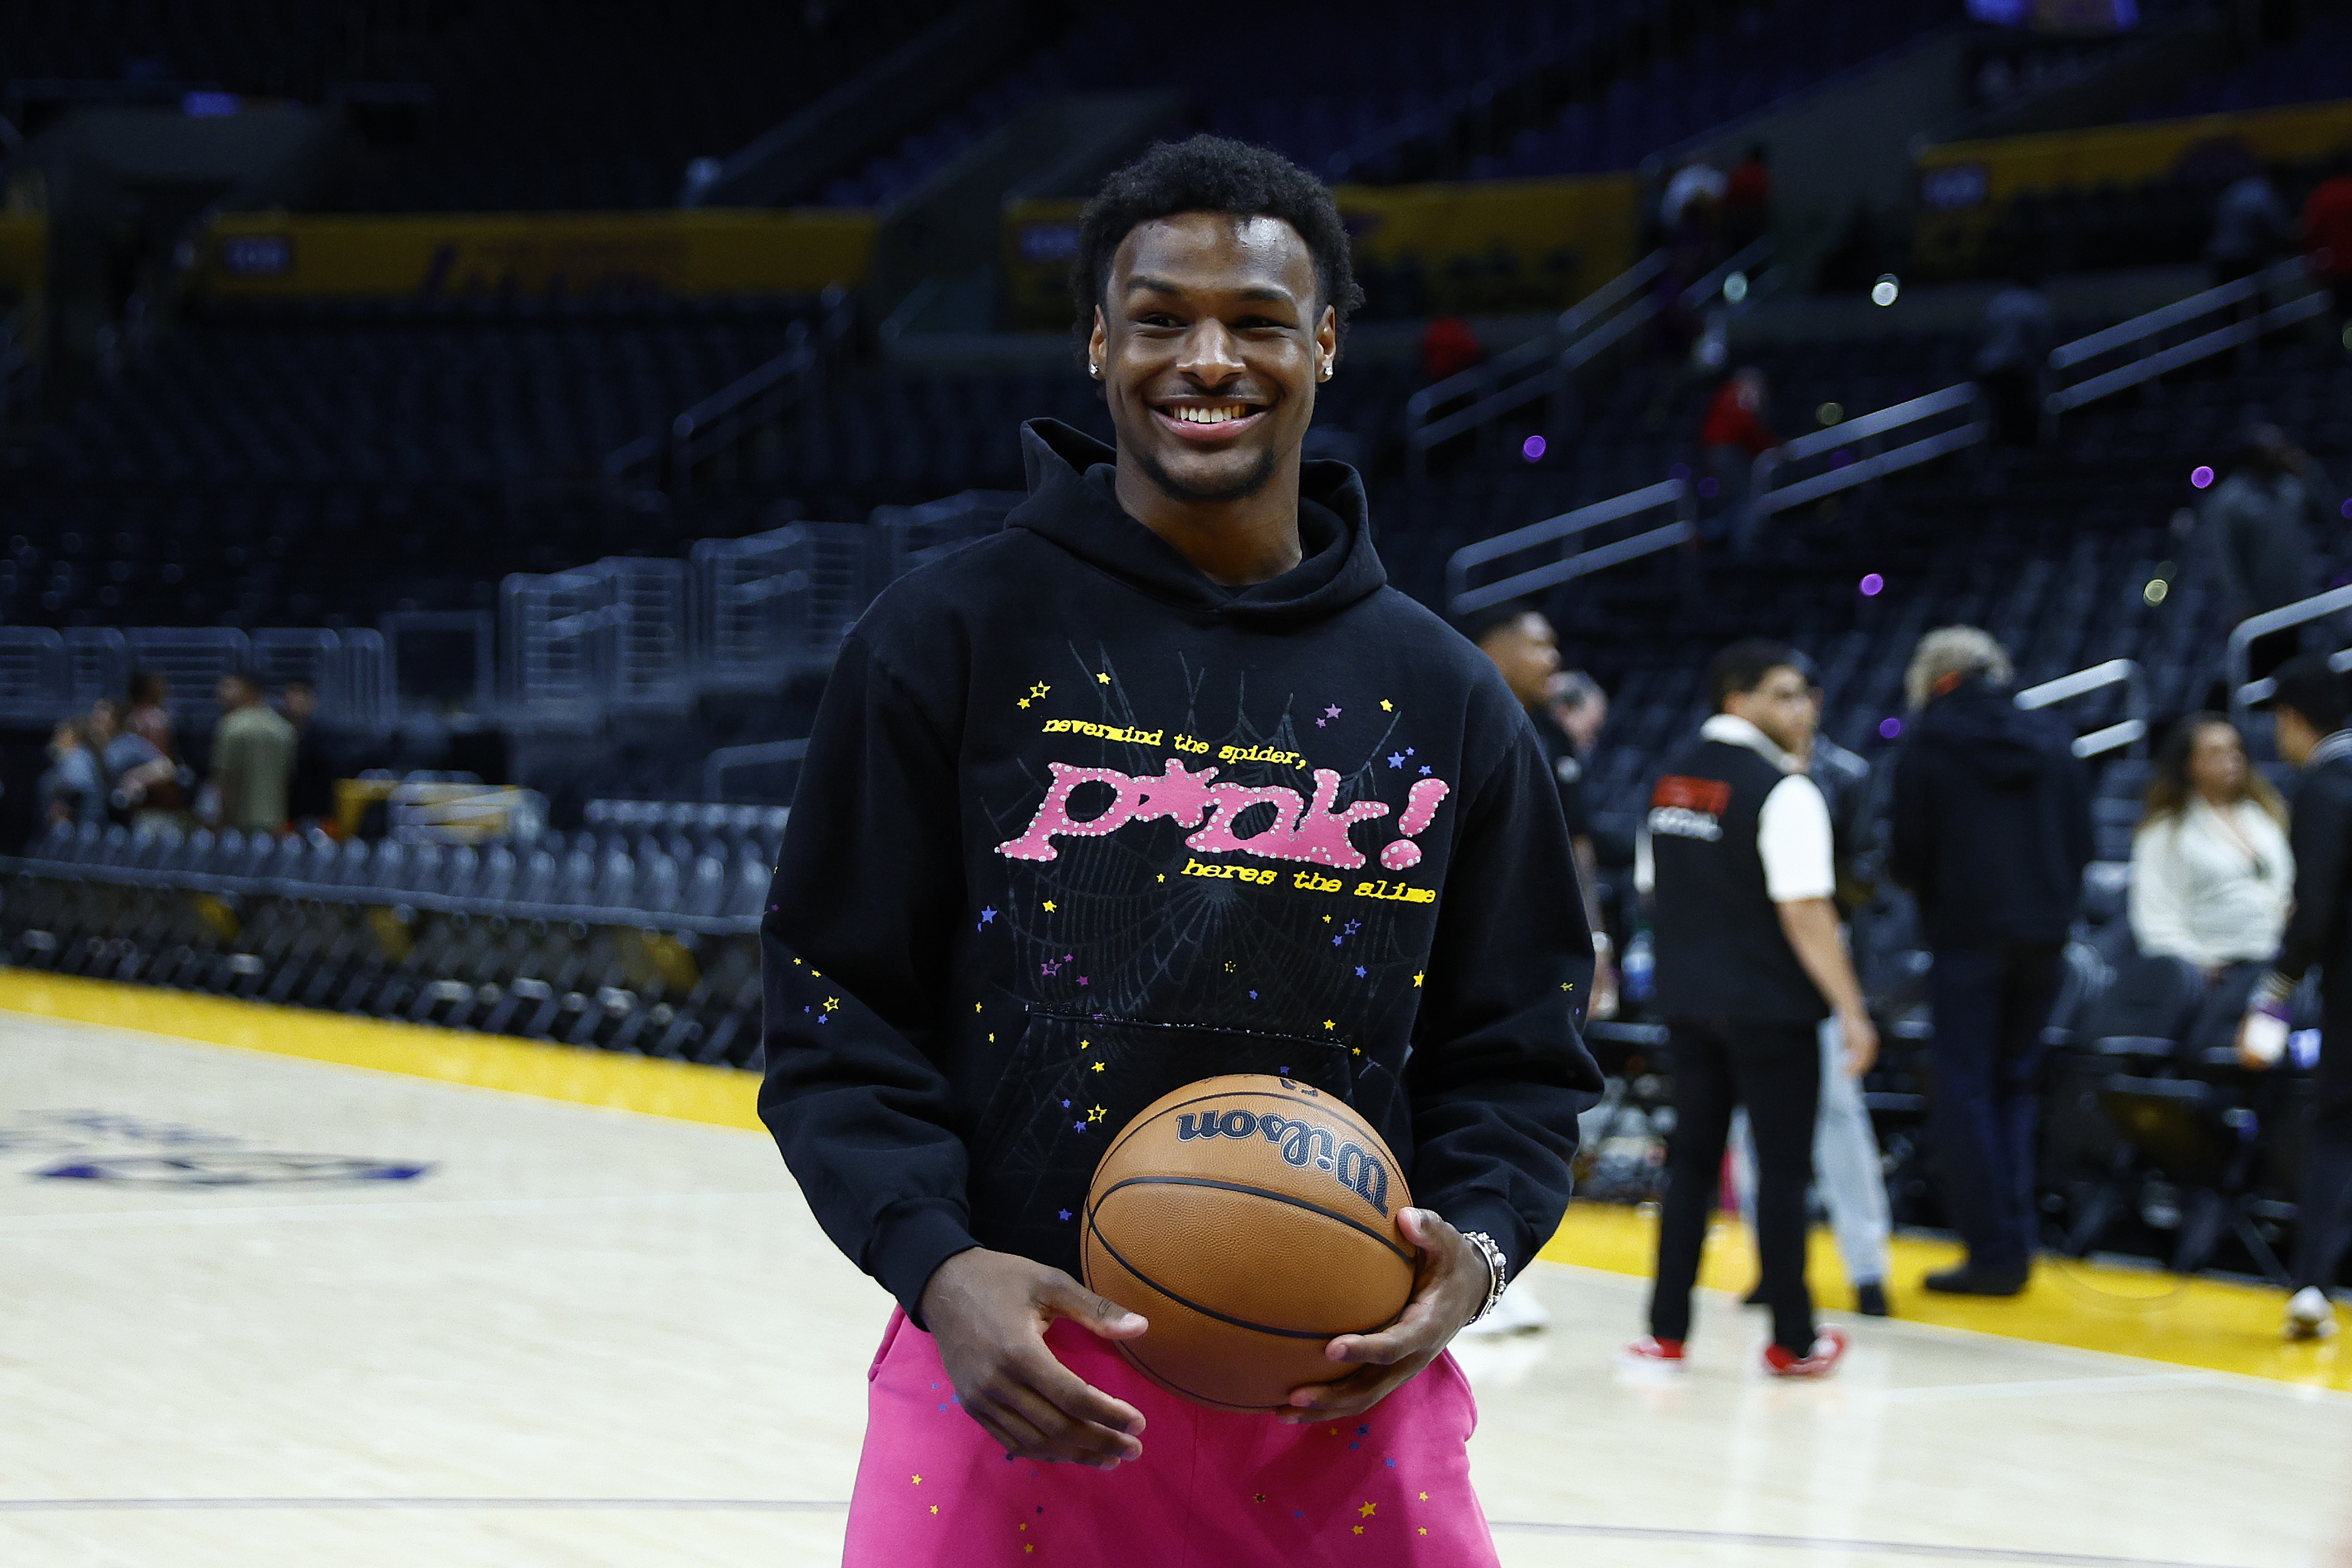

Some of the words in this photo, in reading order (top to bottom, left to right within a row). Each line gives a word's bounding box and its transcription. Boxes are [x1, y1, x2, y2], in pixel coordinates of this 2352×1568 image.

[1042, 718, 1163, 747] nevermind
[1173, 733, 1210, 754] the
[1218, 744, 1307, 770] spider,
[1180, 858, 1278, 886] heres
[1293, 870, 1343, 893] the
[1353, 879, 1437, 903] slime
[1177, 1109, 1388, 1218] Wilson
